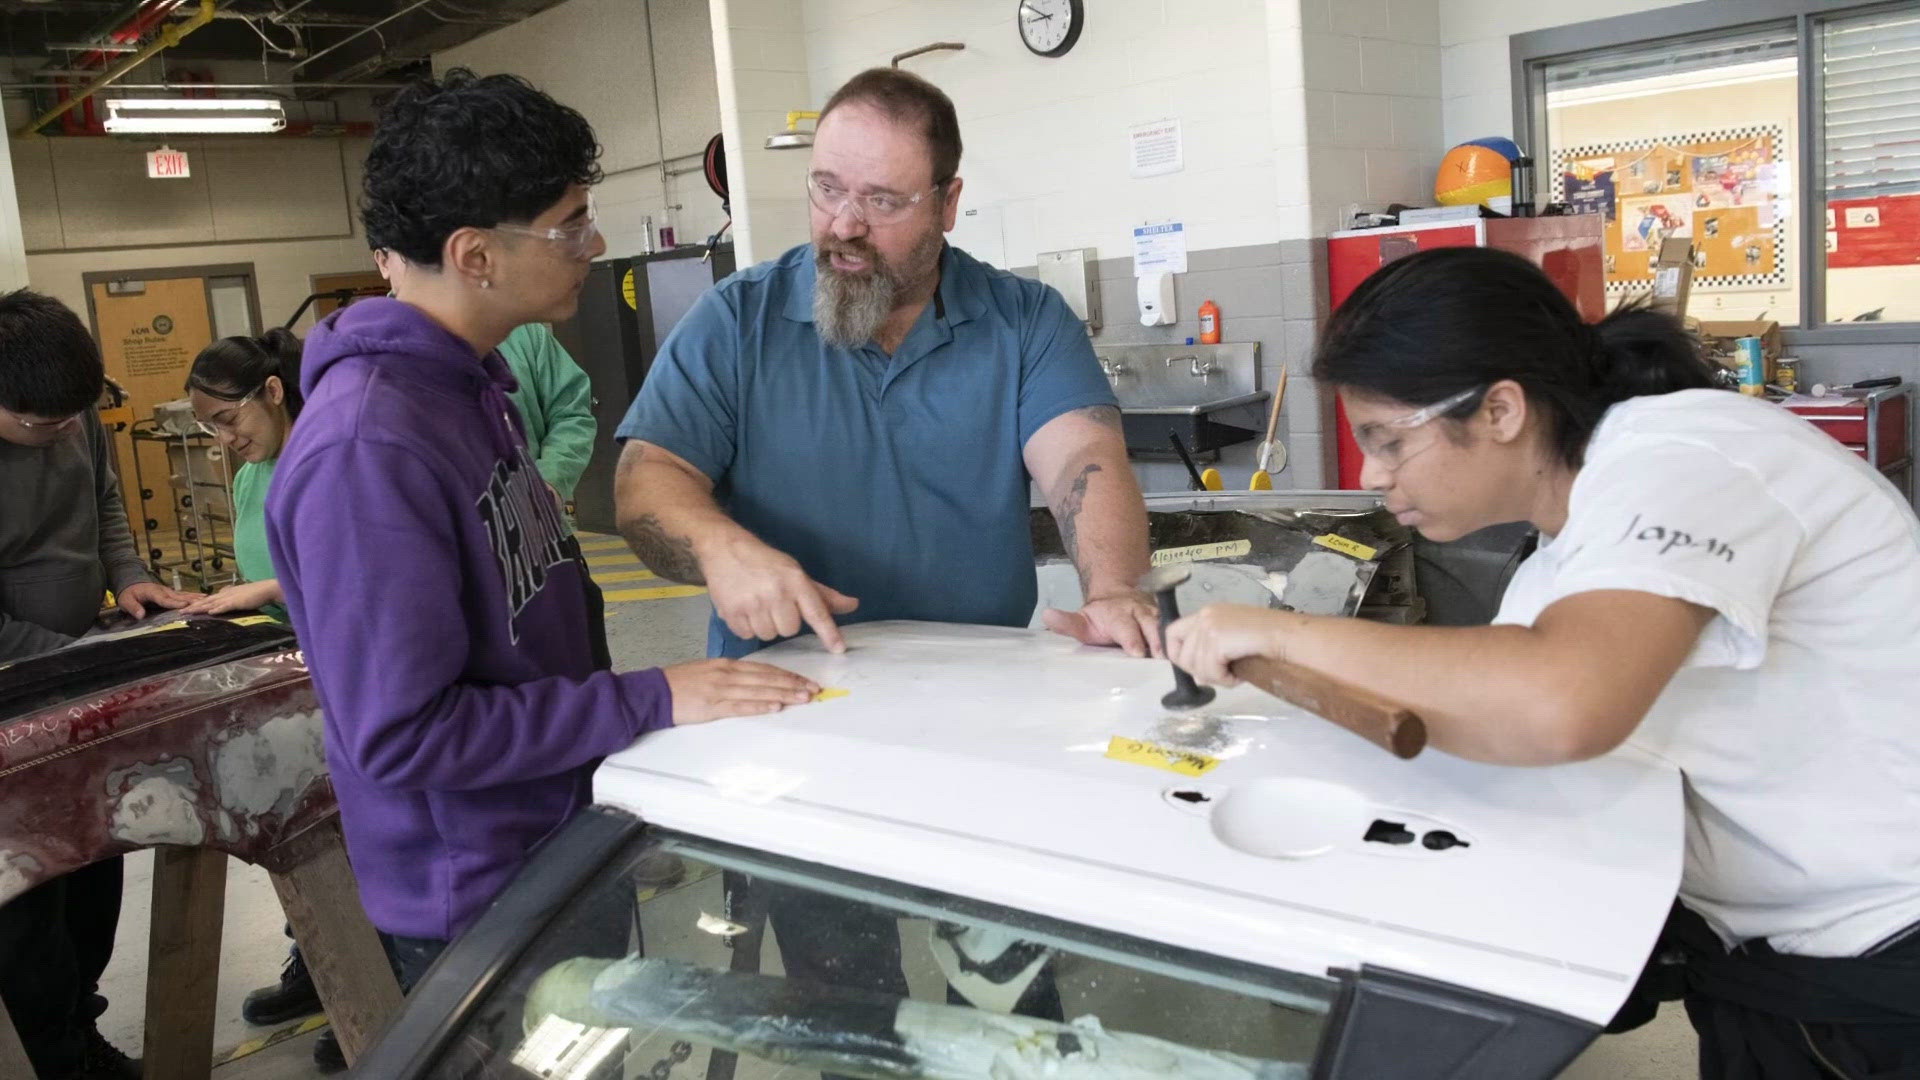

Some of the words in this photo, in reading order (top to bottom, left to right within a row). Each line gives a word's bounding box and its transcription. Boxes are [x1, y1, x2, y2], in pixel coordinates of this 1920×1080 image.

[155, 154, 183, 175] EXIT
[1142, 224, 1174, 235] SHELTER
[122, 337, 144, 345] Shop
[1614, 512, 1735, 563] Japan
[1215, 542, 1238, 555] PM
